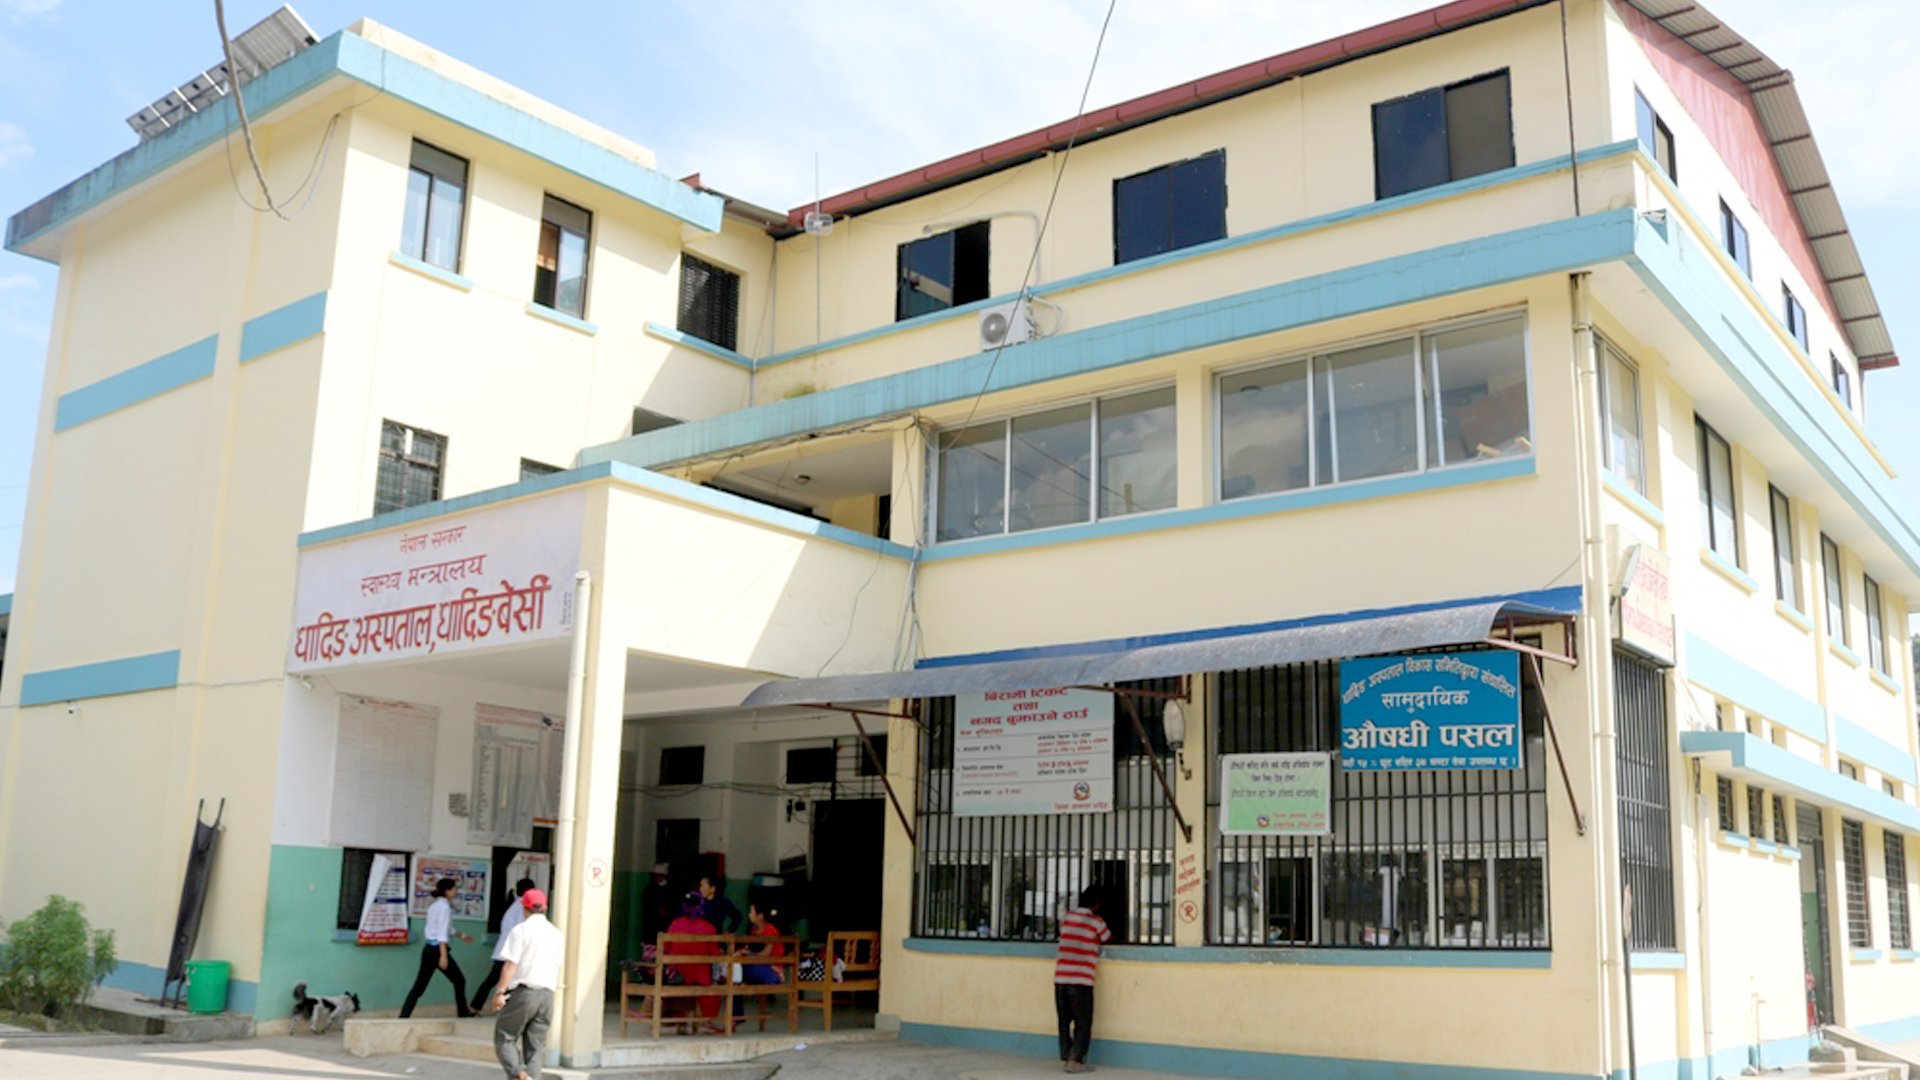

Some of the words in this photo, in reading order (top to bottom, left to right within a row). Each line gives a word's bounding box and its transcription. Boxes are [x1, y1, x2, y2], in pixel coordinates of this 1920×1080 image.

[407, 554, 487, 587] मन्त्रालय
[1013, 702, 1039, 712] तथा
[1381, 686, 1470, 713] सामुदायिक
[1343, 720, 1430, 749] औषधी
[1439, 724, 1515, 748] पसल
